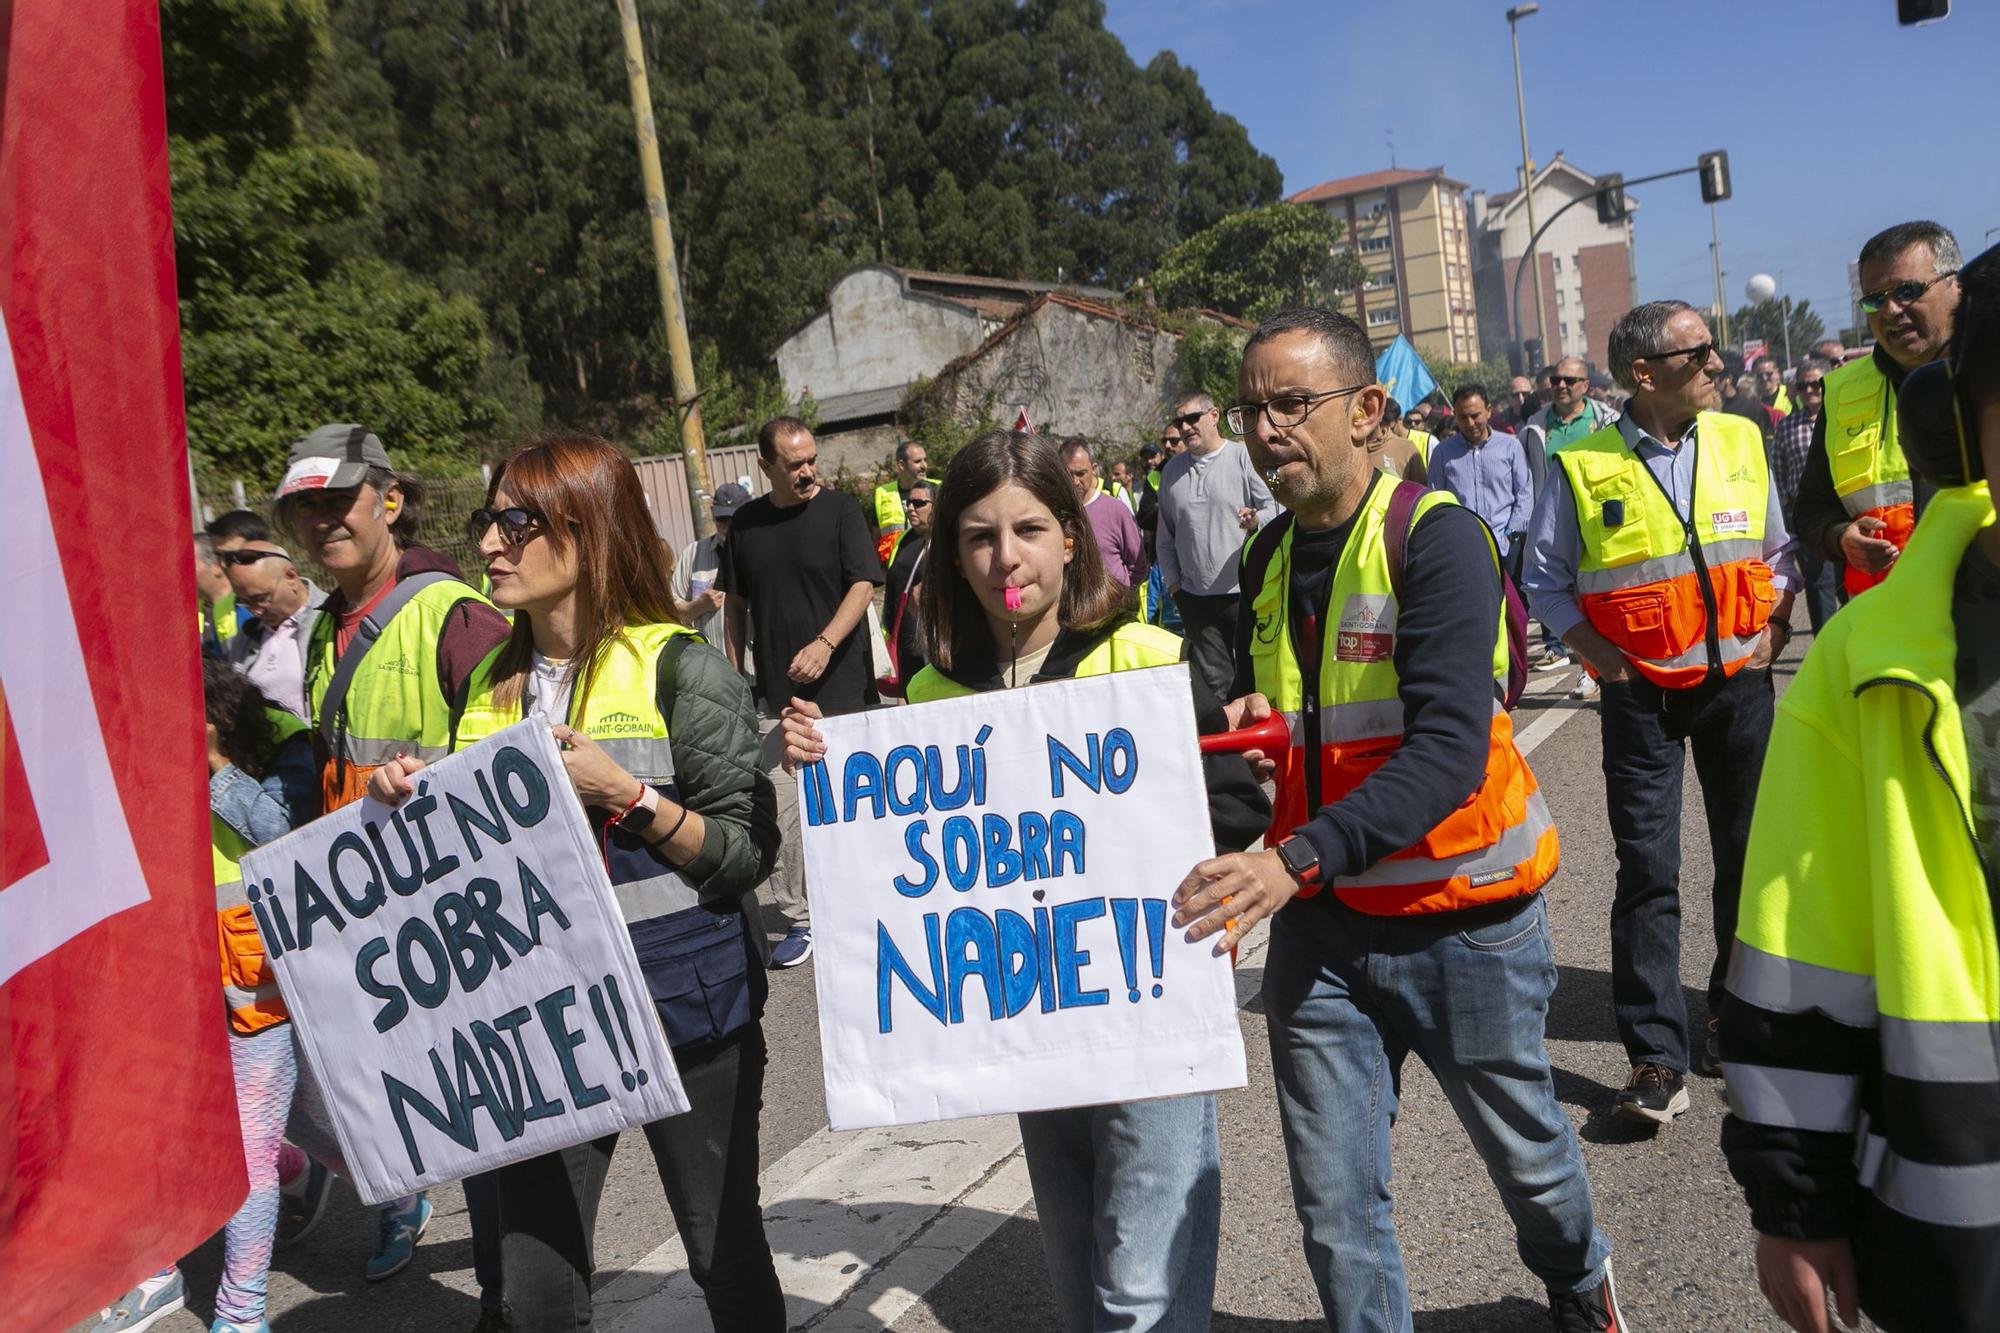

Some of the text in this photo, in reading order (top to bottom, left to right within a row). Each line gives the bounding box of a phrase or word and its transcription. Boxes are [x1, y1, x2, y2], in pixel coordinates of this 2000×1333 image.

[585, 724, 654, 736] SAINT-GOBAIN
[1046, 727, 1139, 799] NO
[247, 745, 551, 960] ¡¡AQUÍ NO
[893, 809, 1086, 898] SOBRA
[354, 855, 572, 1034] SOBRA
[876, 890, 1168, 1034] NADIE!!
[380, 973, 649, 1177] NADIE!!
